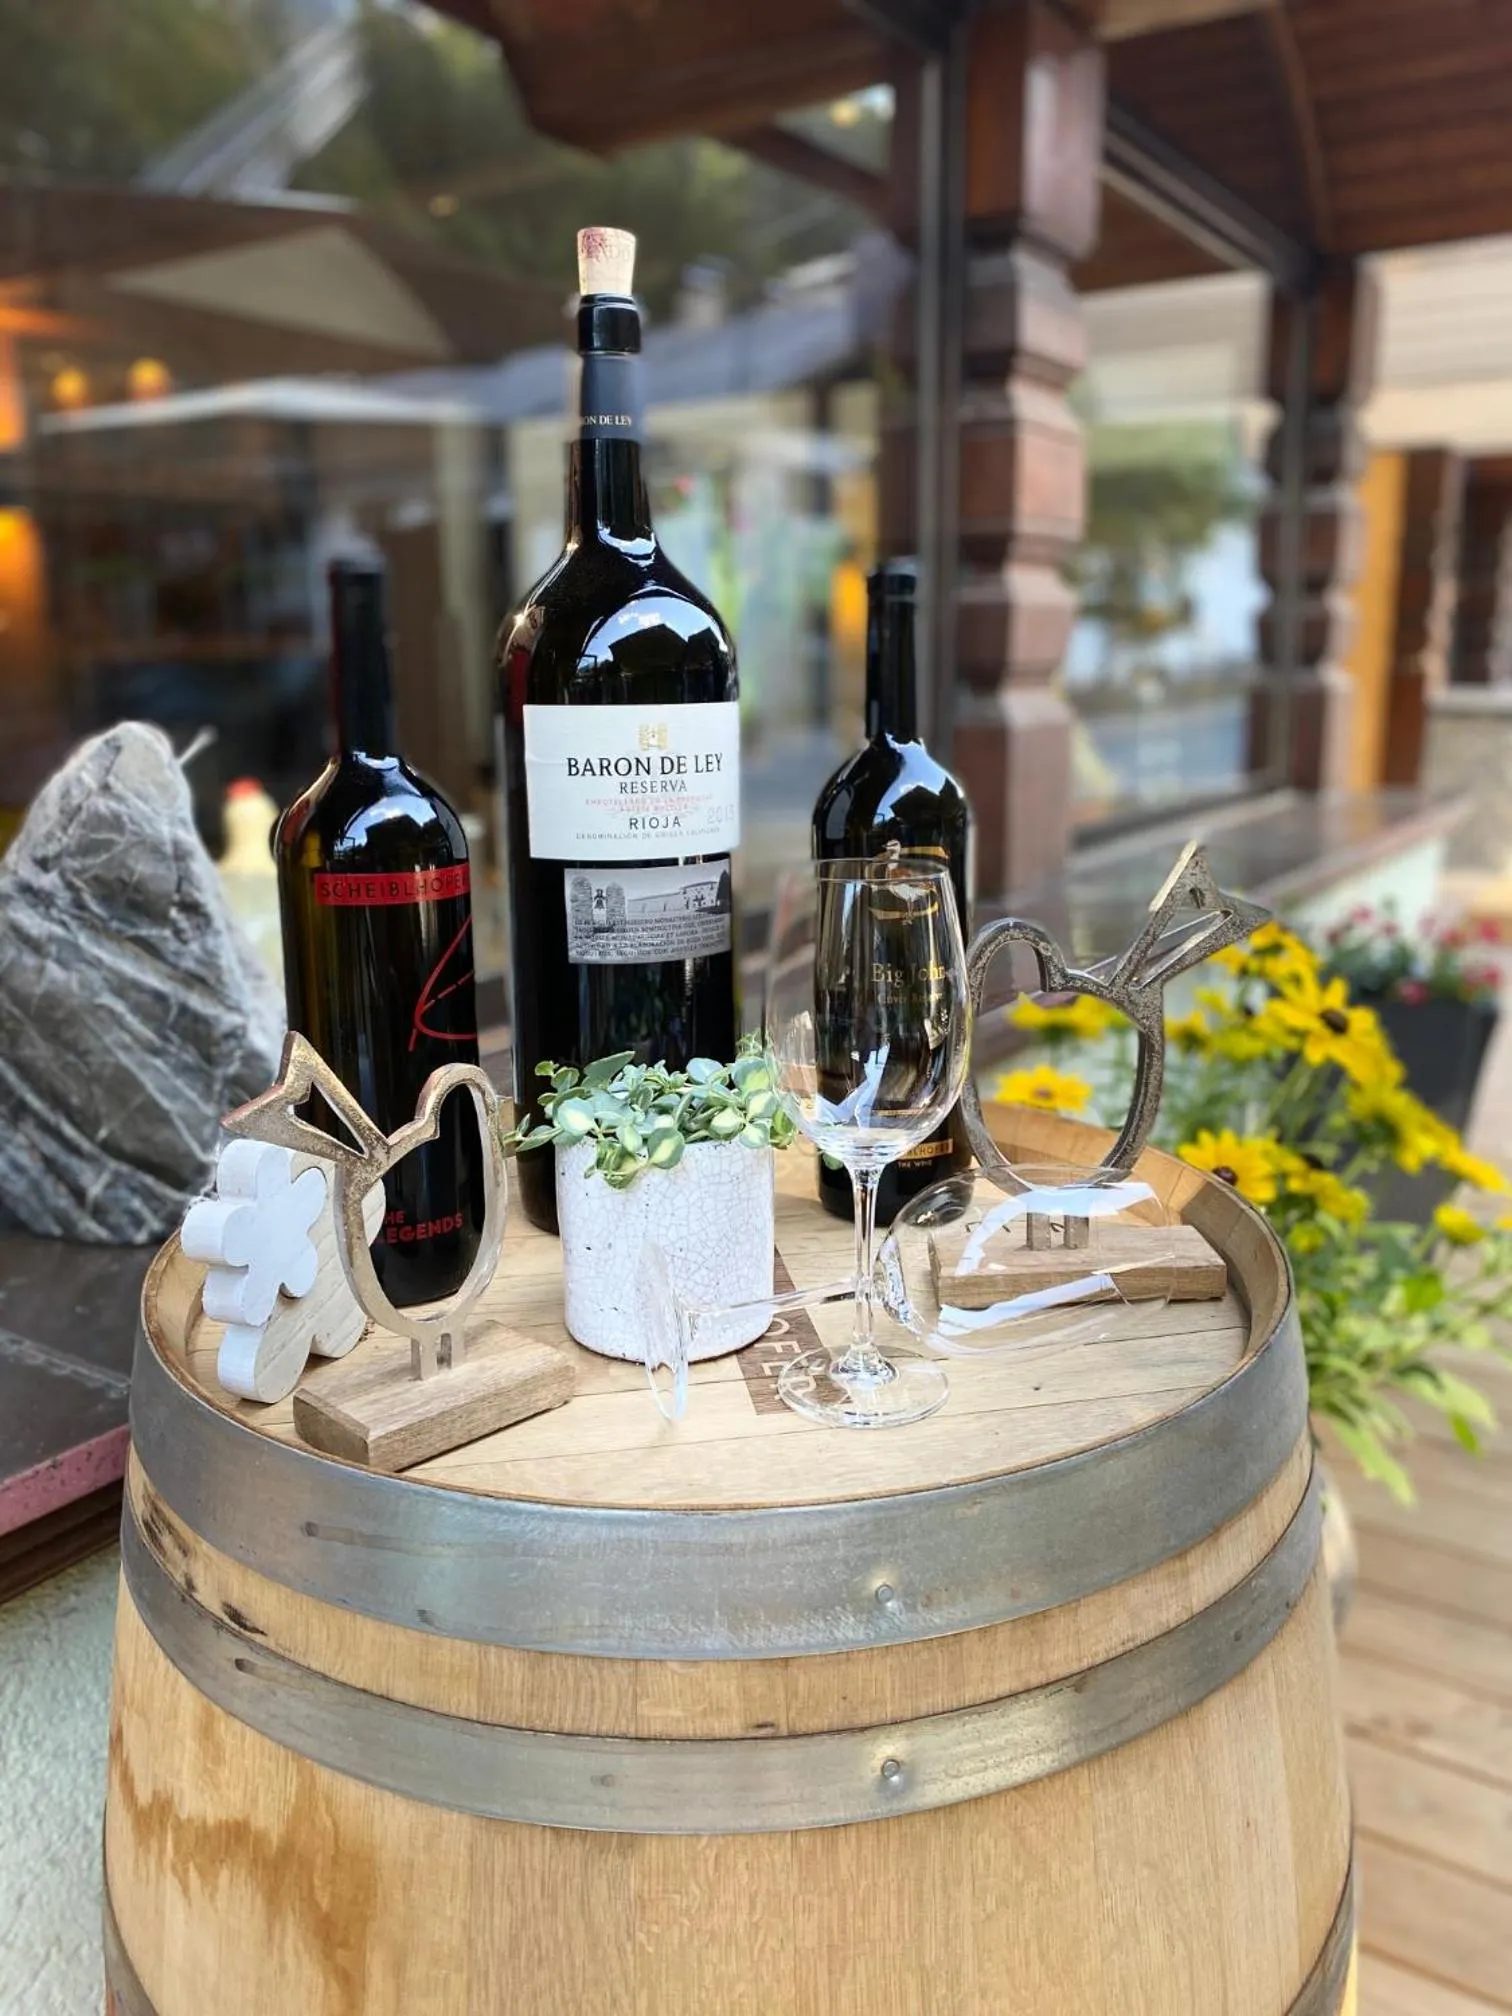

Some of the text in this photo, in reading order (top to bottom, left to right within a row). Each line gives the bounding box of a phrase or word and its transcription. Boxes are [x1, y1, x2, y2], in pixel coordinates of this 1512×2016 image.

[599, 414, 614, 425] DE
[615, 414, 633, 426] LEY
[566, 752, 724, 777] BARON DE LEY
[619, 780, 688, 794] RESERVA
[628, 815, 682, 830] RIOJA
[871, 962, 905, 988] Big
[384, 1211, 405, 1225] HE
